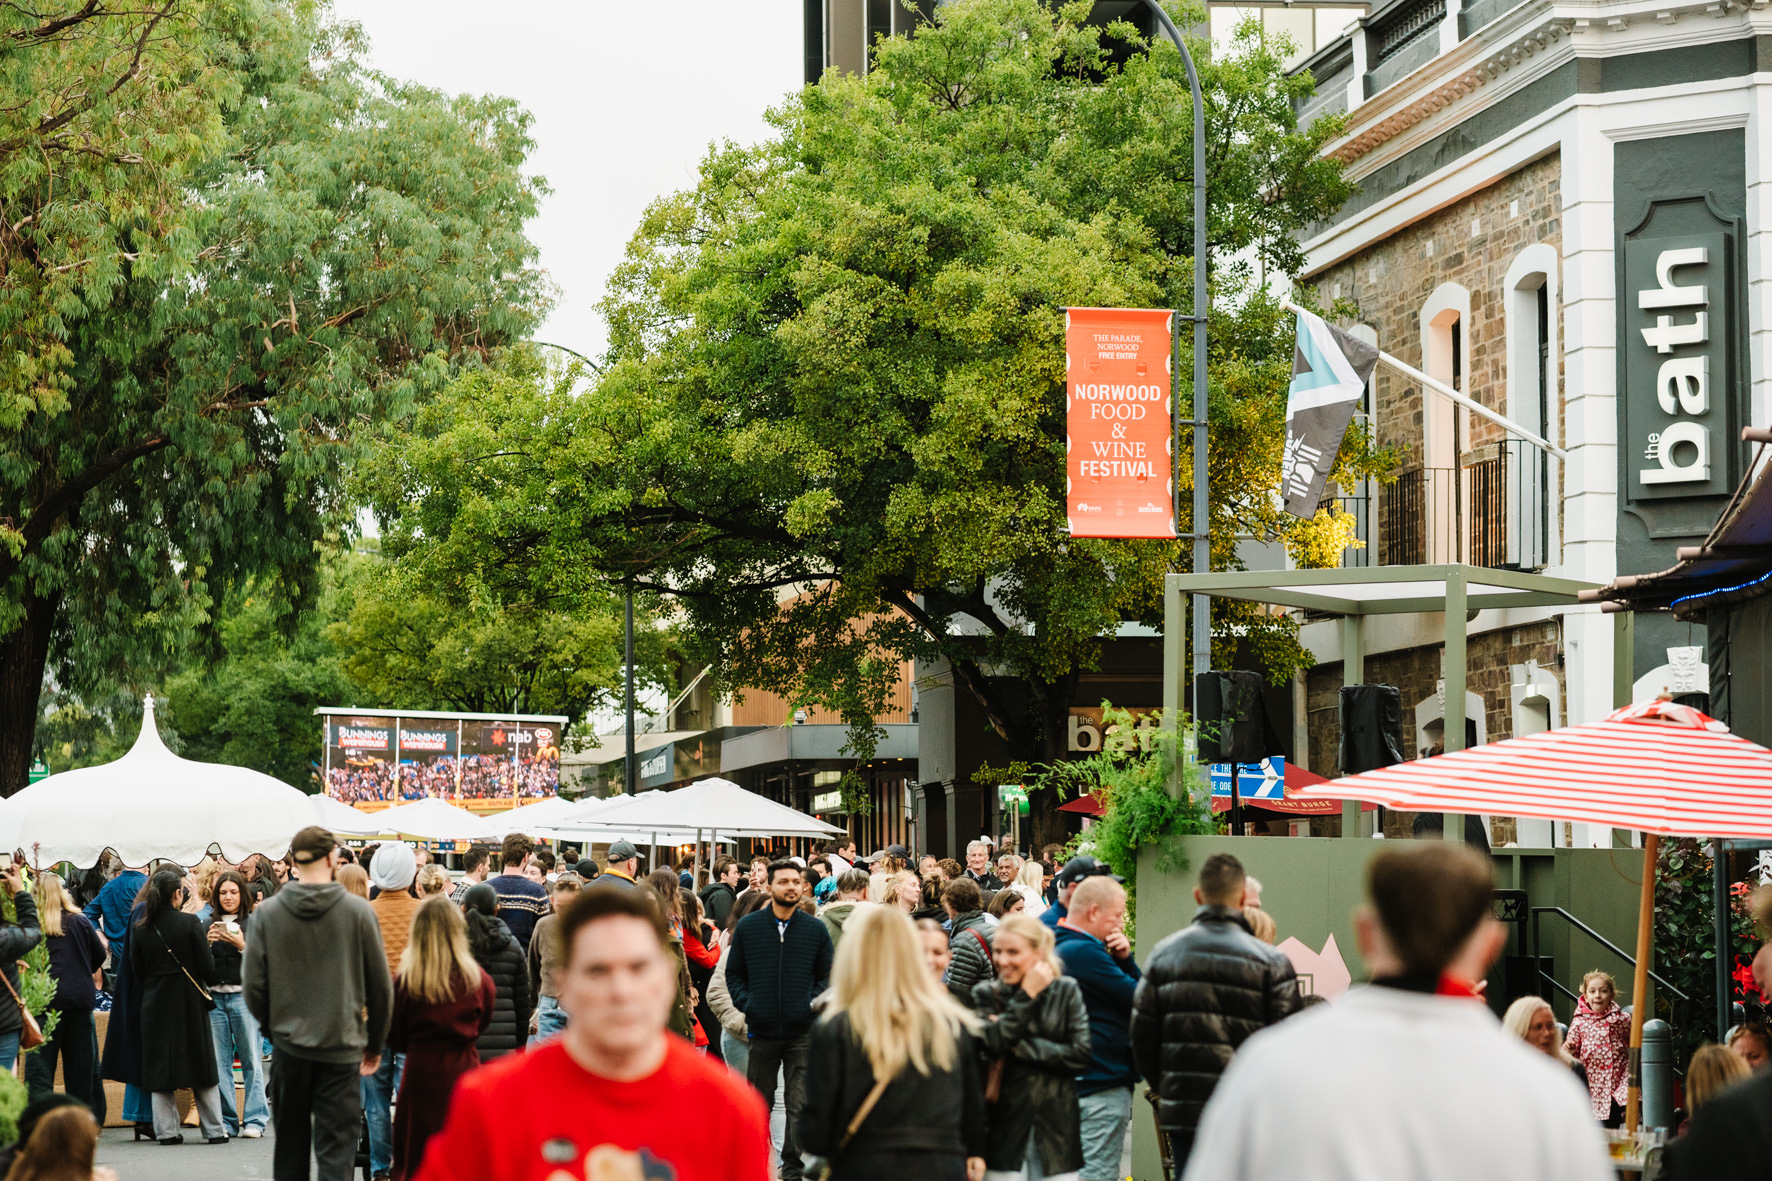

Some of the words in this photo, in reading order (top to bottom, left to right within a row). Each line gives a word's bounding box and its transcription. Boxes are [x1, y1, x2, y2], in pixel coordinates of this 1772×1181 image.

[1110, 335, 1143, 343] PARADE,
[1097, 343, 1139, 351] NORWOOD
[1116, 352, 1137, 360] ENTRY
[1638, 247, 1710, 484] bath
[1075, 384, 1161, 401] NORWOOD
[1090, 403, 1146, 420] FOOD
[1112, 423, 1127, 439] &
[1091, 441, 1146, 458] WINE
[1644, 432, 1660, 460] the
[1080, 460, 1157, 478] FESTIVAL
[1080, 716, 1093, 724] the
[339, 726, 388, 740] BUNNINGS
[400, 729, 447, 743] BUNNINGS
[507, 730, 533, 743] nab
[1068, 715, 1164, 752] bat
[342, 738, 386, 748] warehouse
[403, 741, 444, 750] warehouse
[1271, 800, 1299, 808] GRANT
[1300, 800, 1333, 808] BURGE
